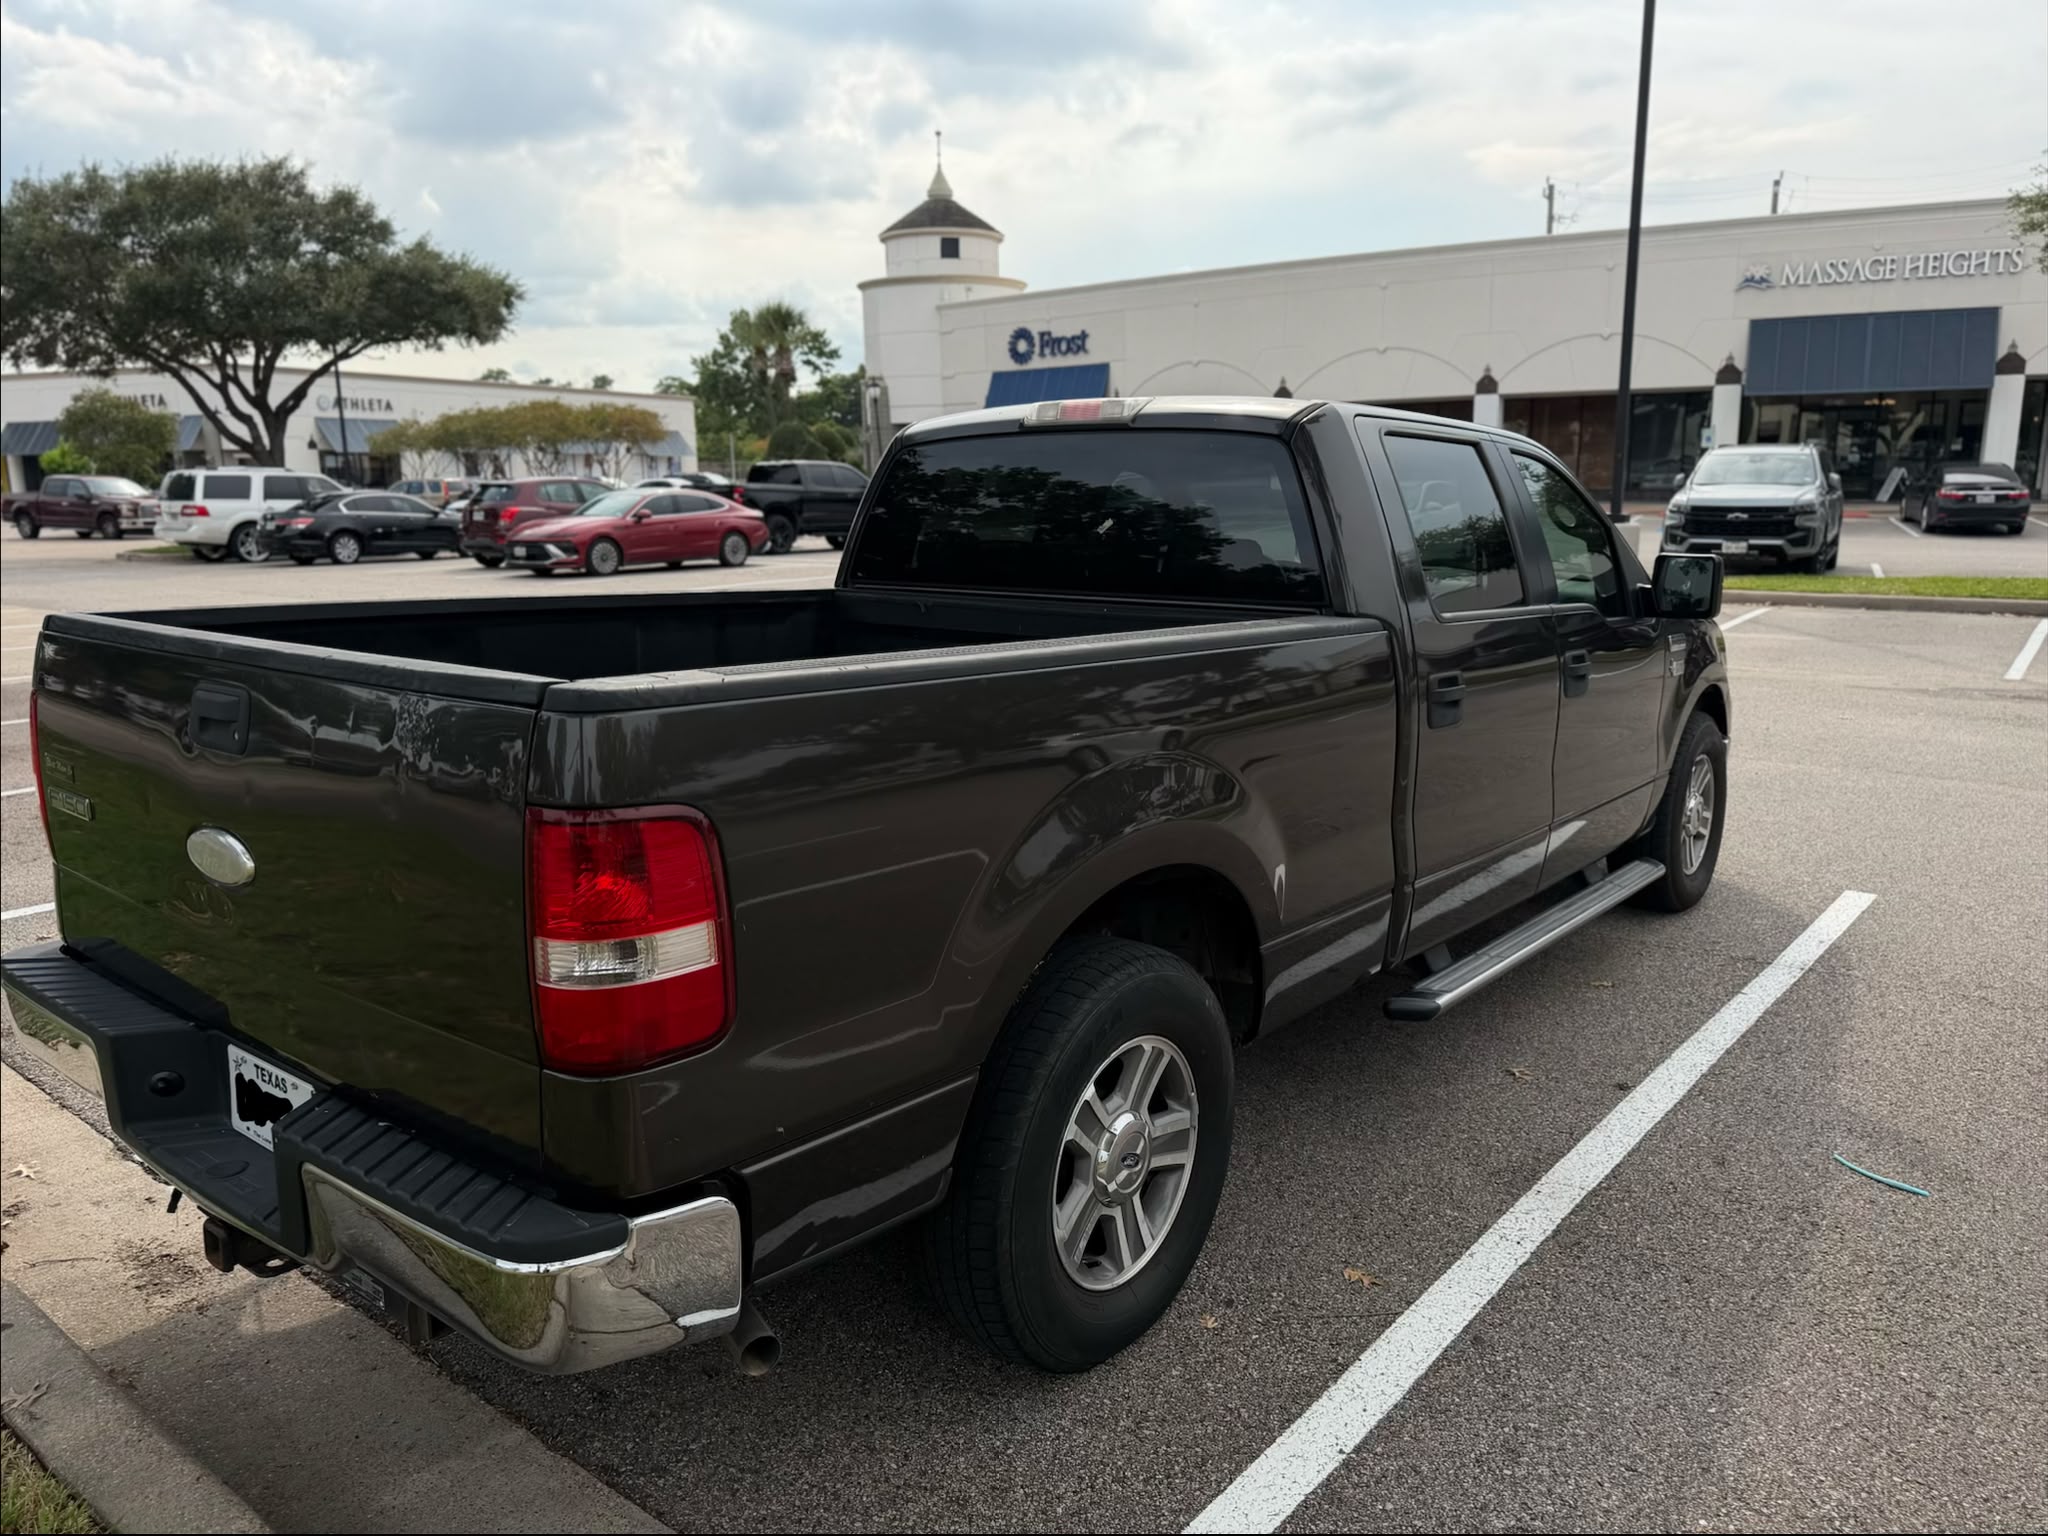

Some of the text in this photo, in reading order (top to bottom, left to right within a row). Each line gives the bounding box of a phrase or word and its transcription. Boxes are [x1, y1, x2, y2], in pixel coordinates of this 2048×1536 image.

[1780, 248, 2024, 286] MASSAGE HEIGHTS
[1038, 329, 1089, 358] Frost
[332, 396, 394, 412] ATHLETA
[253, 1063, 288, 1094] TEXAS
